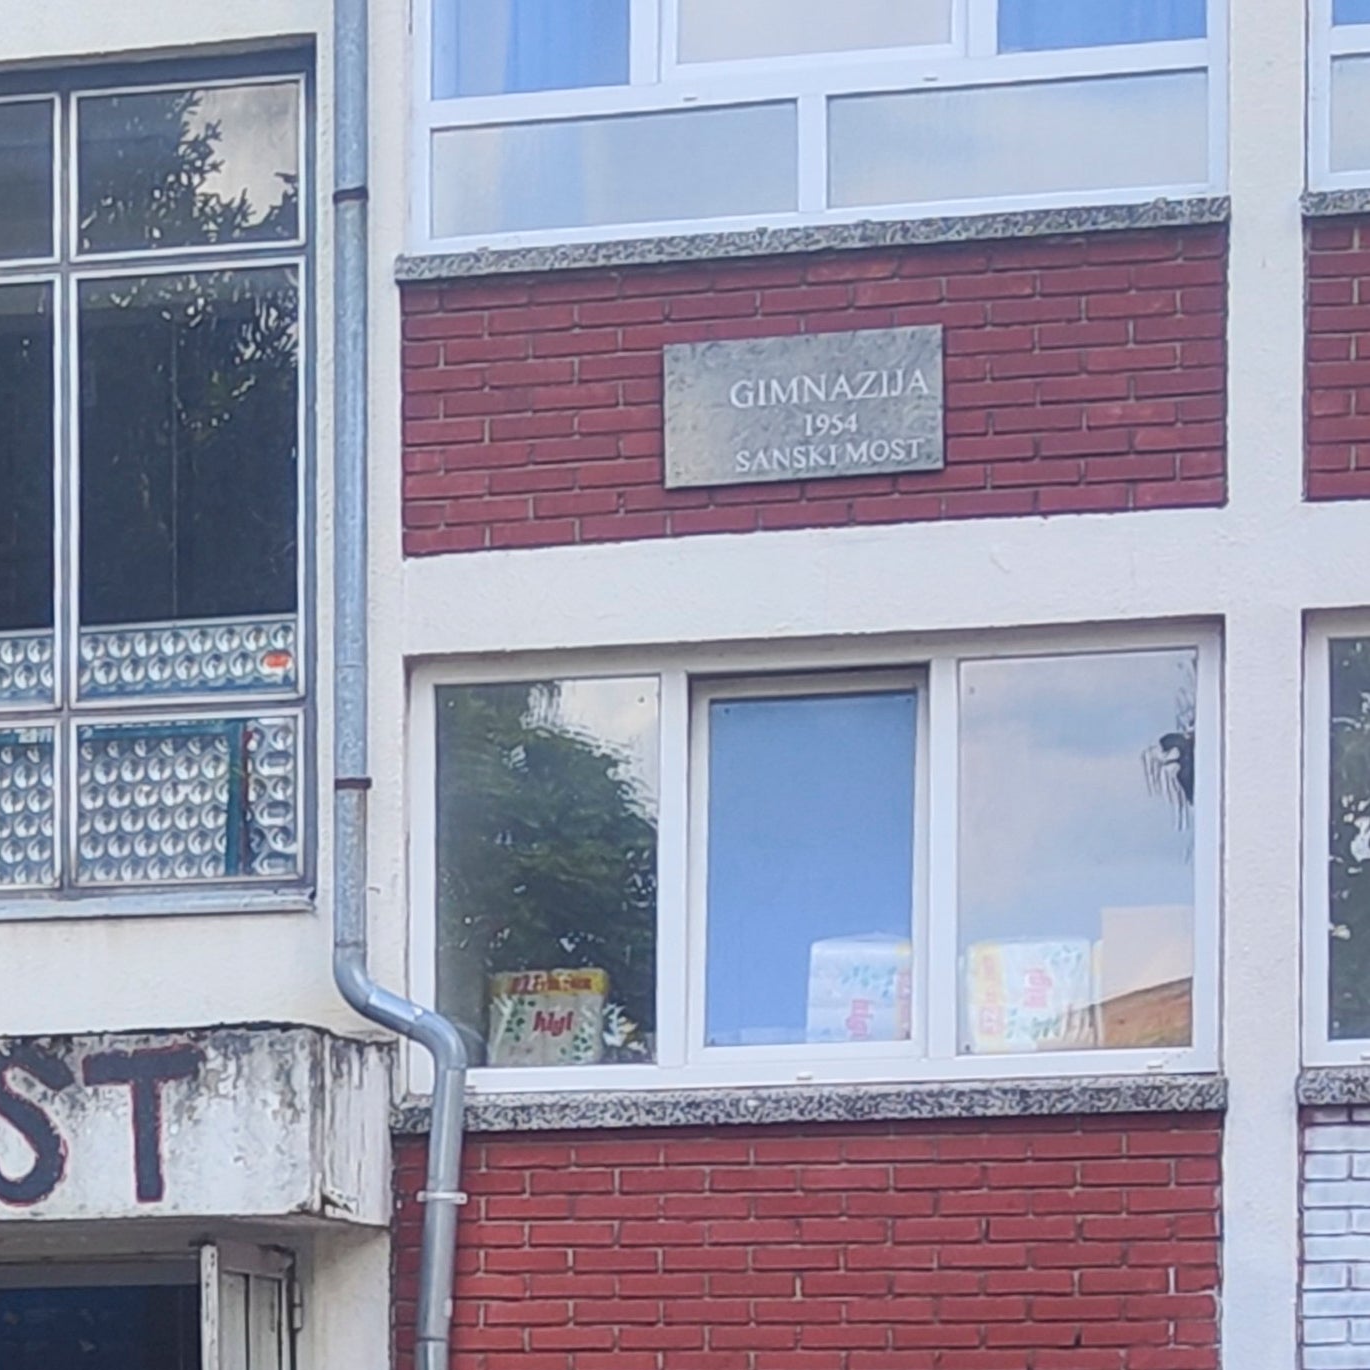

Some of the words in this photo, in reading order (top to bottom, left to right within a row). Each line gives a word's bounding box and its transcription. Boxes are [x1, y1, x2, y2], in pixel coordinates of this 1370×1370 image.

[729, 368, 929, 408] GIMNAZIJA
[804, 413, 859, 436] 1954
[735, 446, 839, 473] SANSKI
[845, 438, 926, 464] MOST
